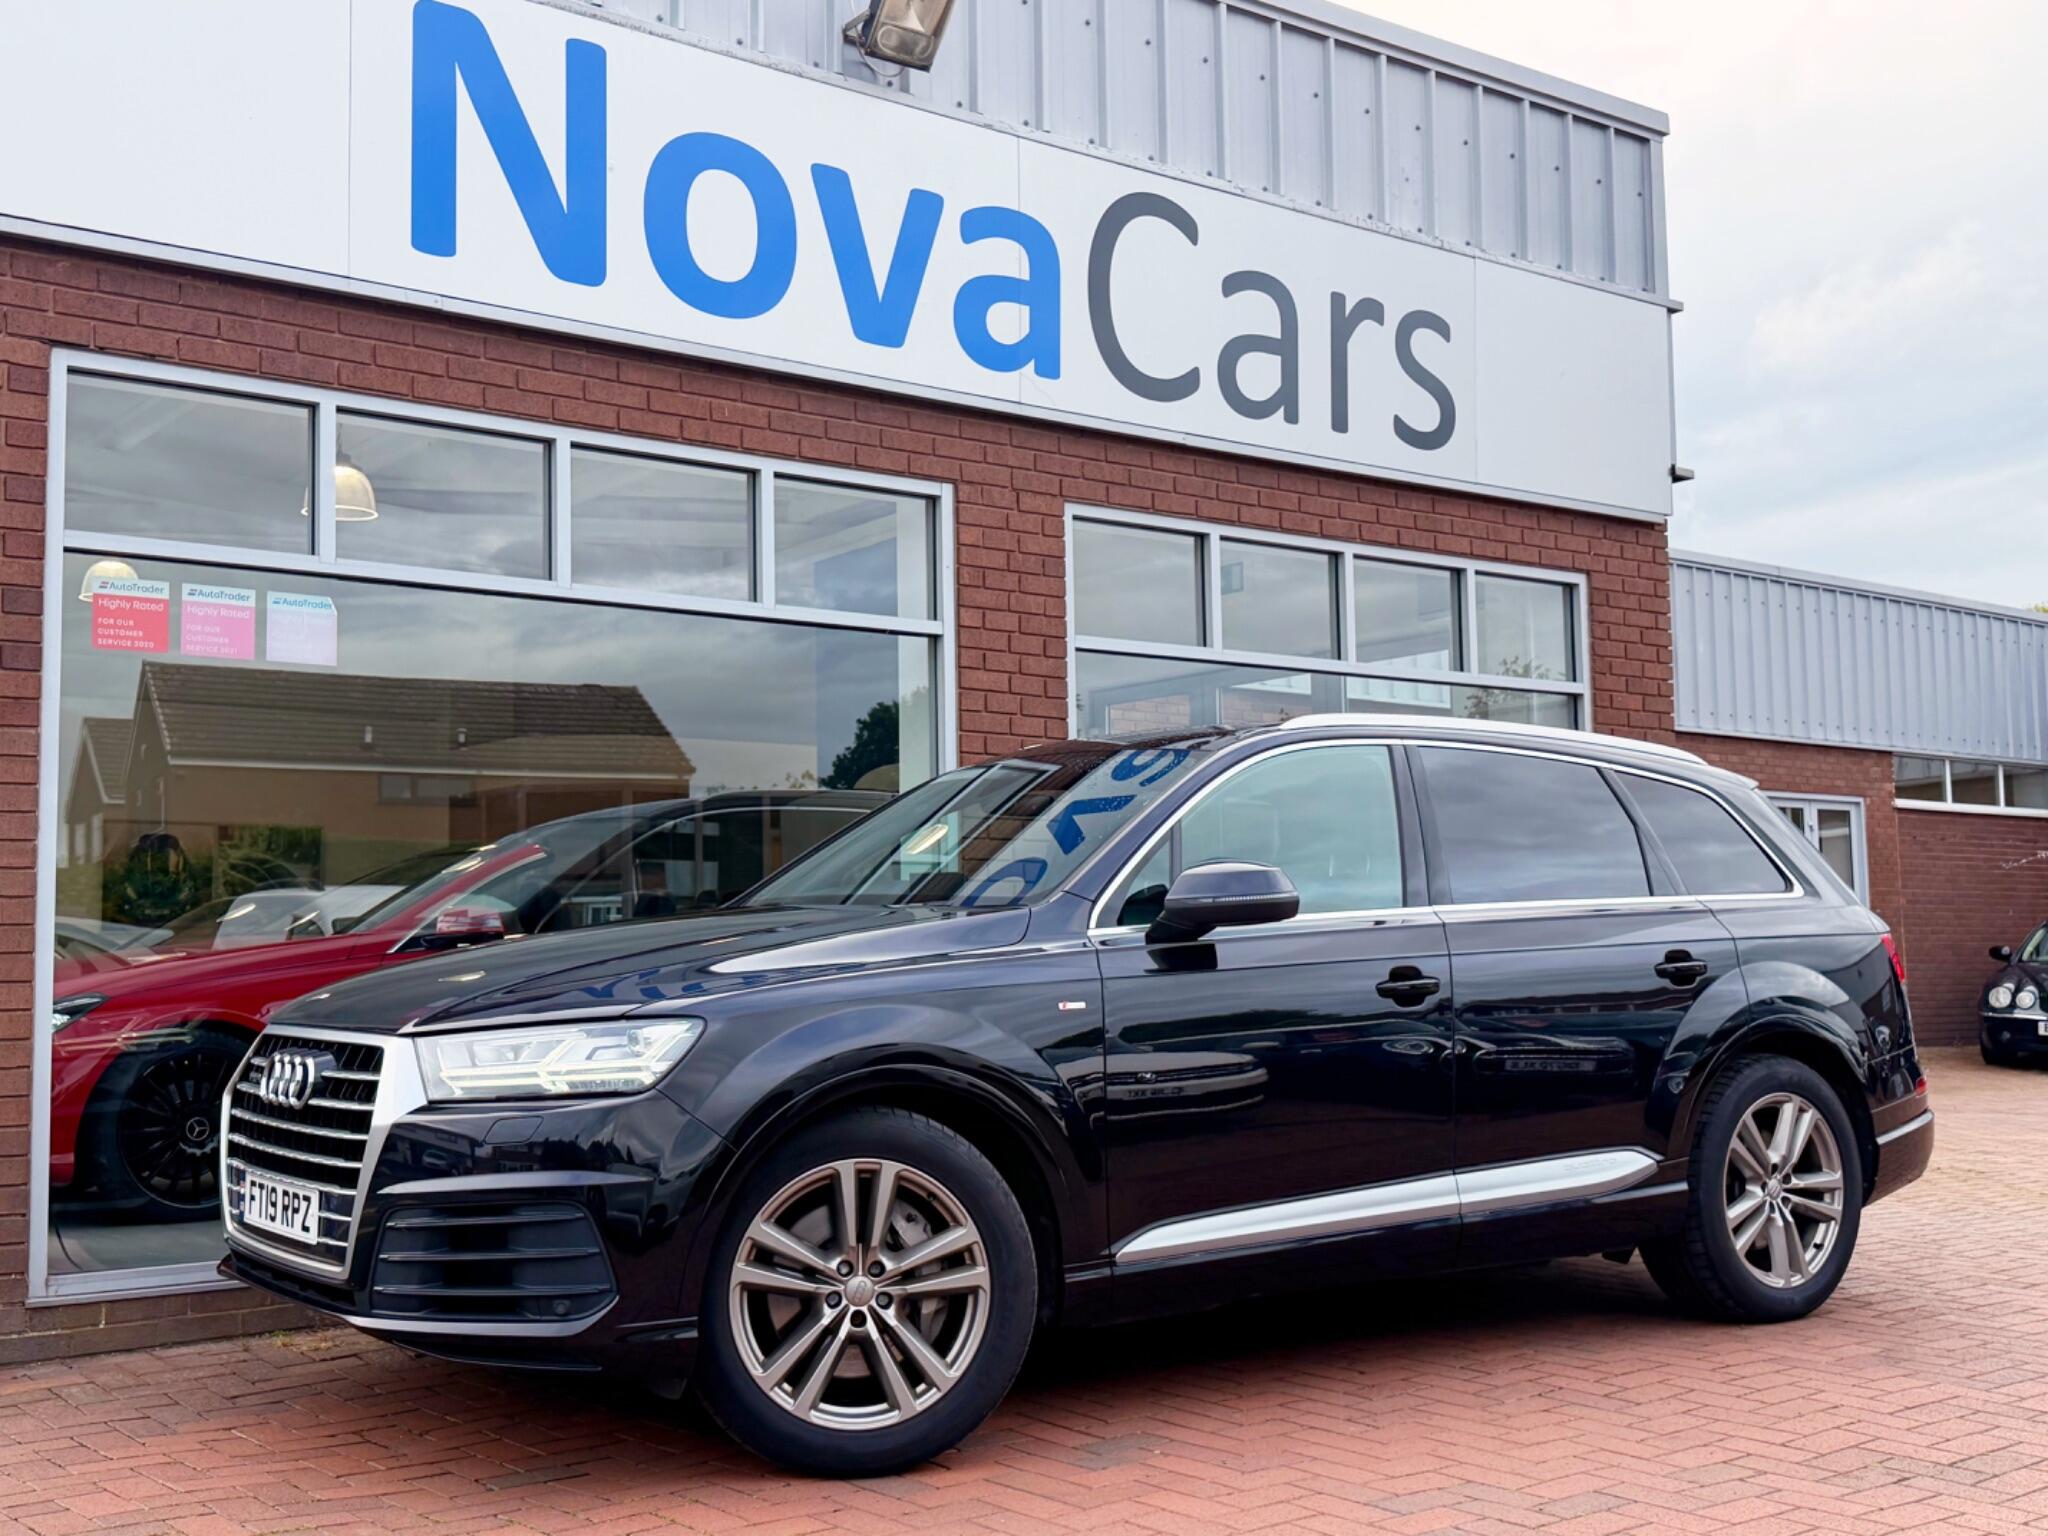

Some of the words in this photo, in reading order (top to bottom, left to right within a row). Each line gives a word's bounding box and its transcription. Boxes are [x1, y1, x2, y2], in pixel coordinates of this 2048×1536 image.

[110, 582, 165, 595] AutoTrader
[198, 588, 251, 602] AutoTrader
[98, 598, 131, 611] Highly
[132, 600, 164, 612] Rated
[187, 604, 218, 617] Highly
[97, 628, 144, 637] CUSTOMER
[97, 638, 132, 647] SERVICE
[249, 1180, 278, 1223] FT19
[281, 1189, 312, 1233] RPZ
